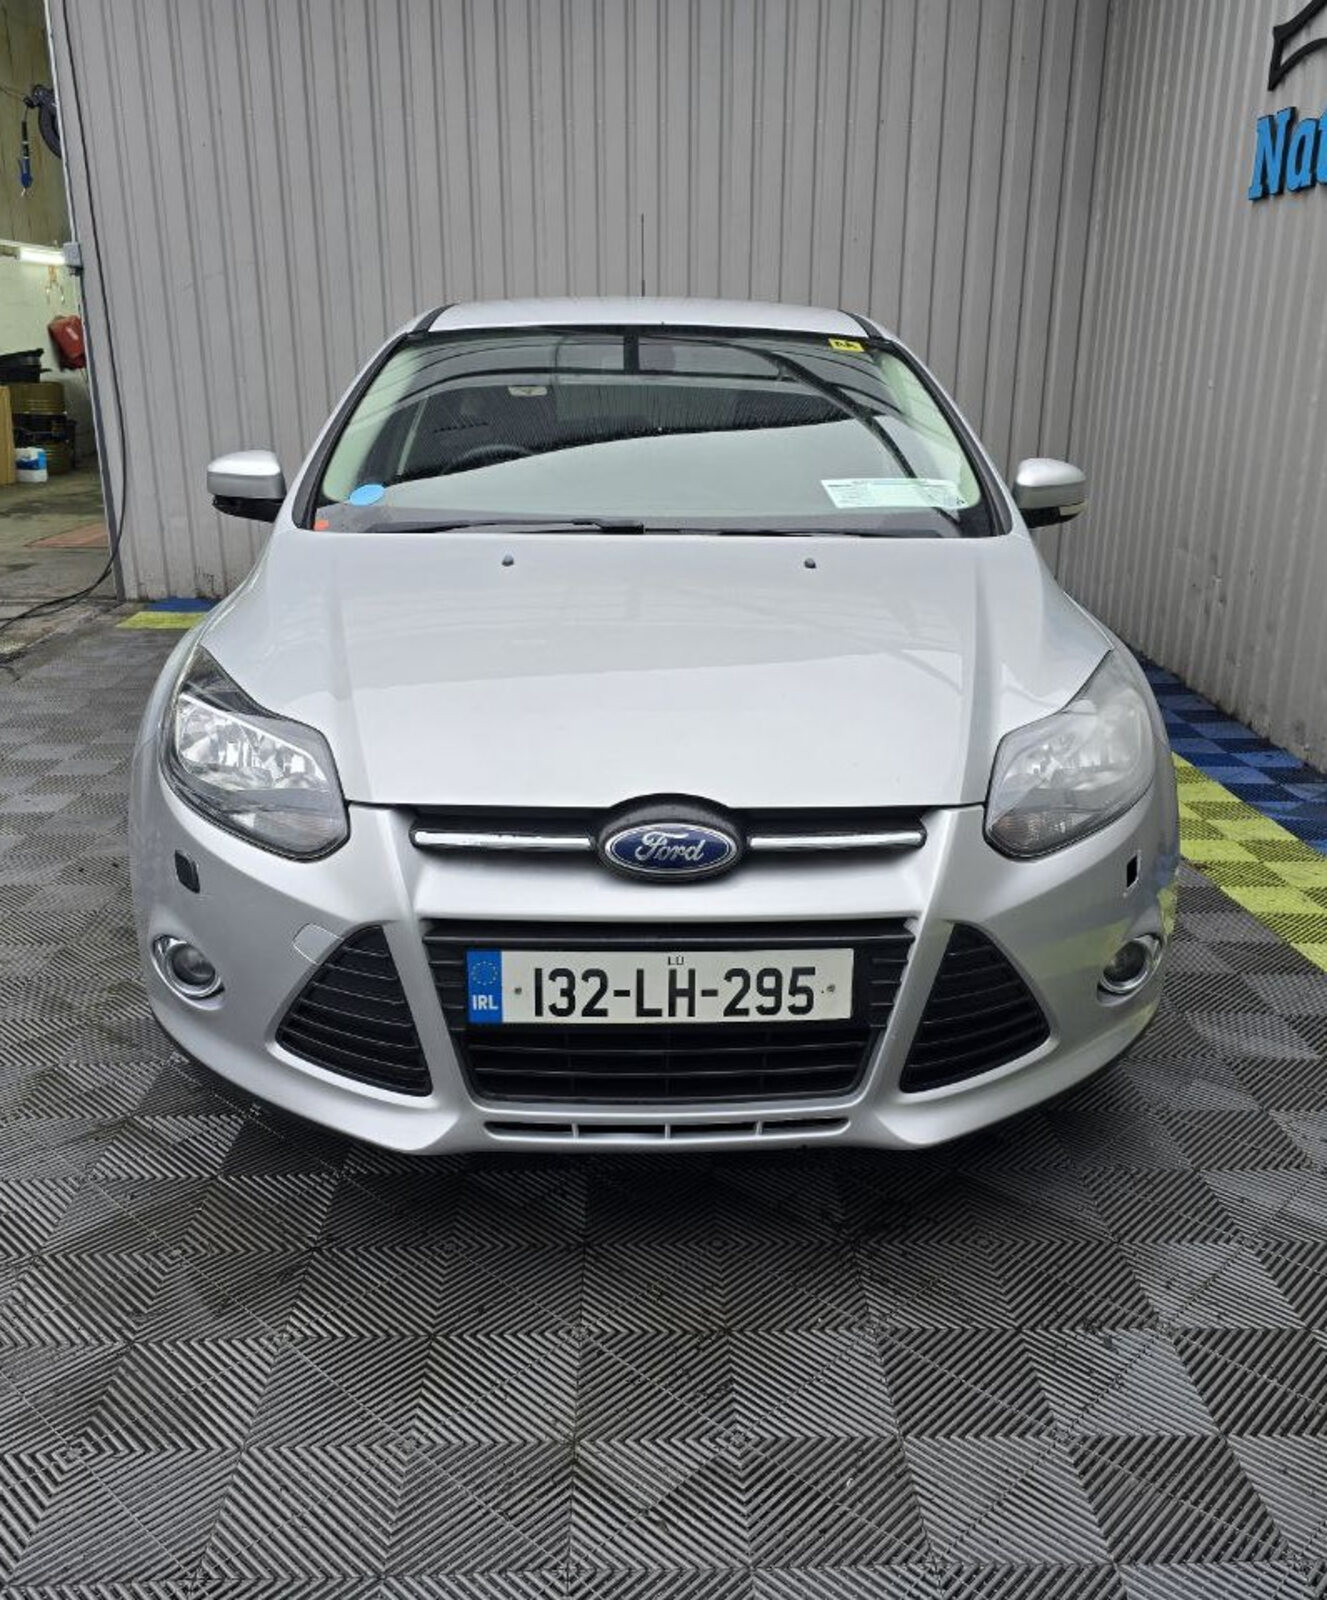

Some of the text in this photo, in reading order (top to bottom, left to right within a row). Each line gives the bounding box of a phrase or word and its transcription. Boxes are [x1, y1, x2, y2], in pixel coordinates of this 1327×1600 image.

[635, 831, 706, 861] Ford
[472, 994, 499, 1010] IRL
[534, 966, 816, 1018] 132-LH-295
